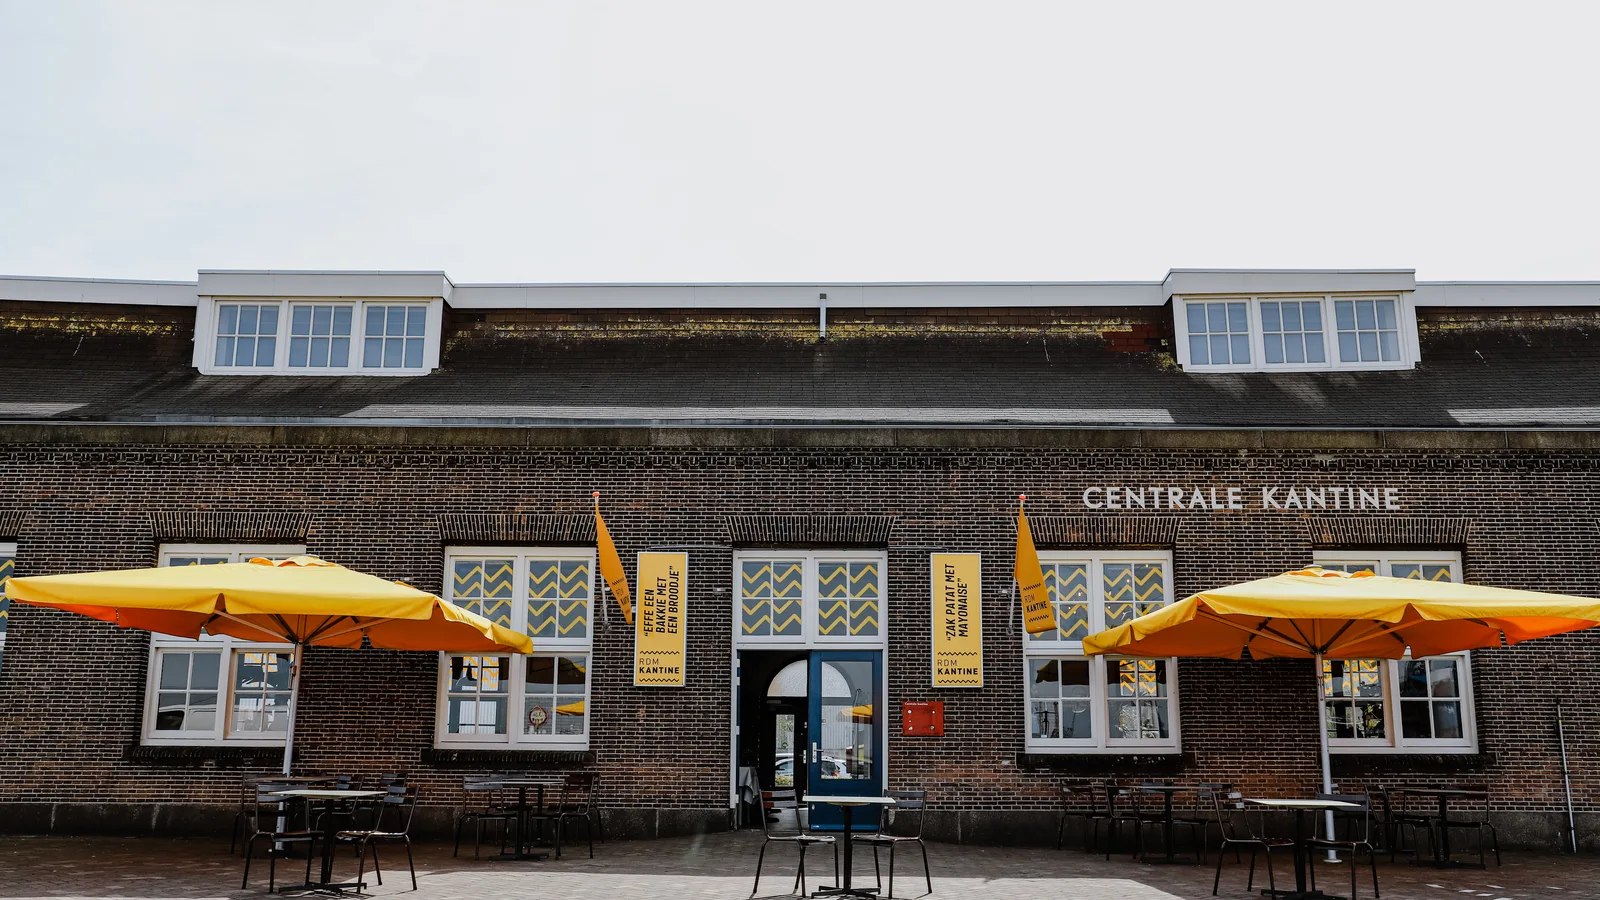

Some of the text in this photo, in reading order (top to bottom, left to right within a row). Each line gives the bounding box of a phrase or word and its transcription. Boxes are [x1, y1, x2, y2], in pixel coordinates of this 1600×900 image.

[1082, 486, 1400, 510] CENTRALE KANTINE
[944, 564, 955, 583] MET
[644, 589, 654, 607] EEN
[655, 577, 667, 633] BAKKIE MET
[945, 585, 956, 615] PATAT
[1026, 600, 1048, 613] KANTINE
[667, 616, 678, 634] EEN
[639, 657, 659, 666] RDM
[639, 666, 680, 674] KANTINE
[937, 659, 958, 667] RDM
[937, 667, 978, 675] KANTINE
